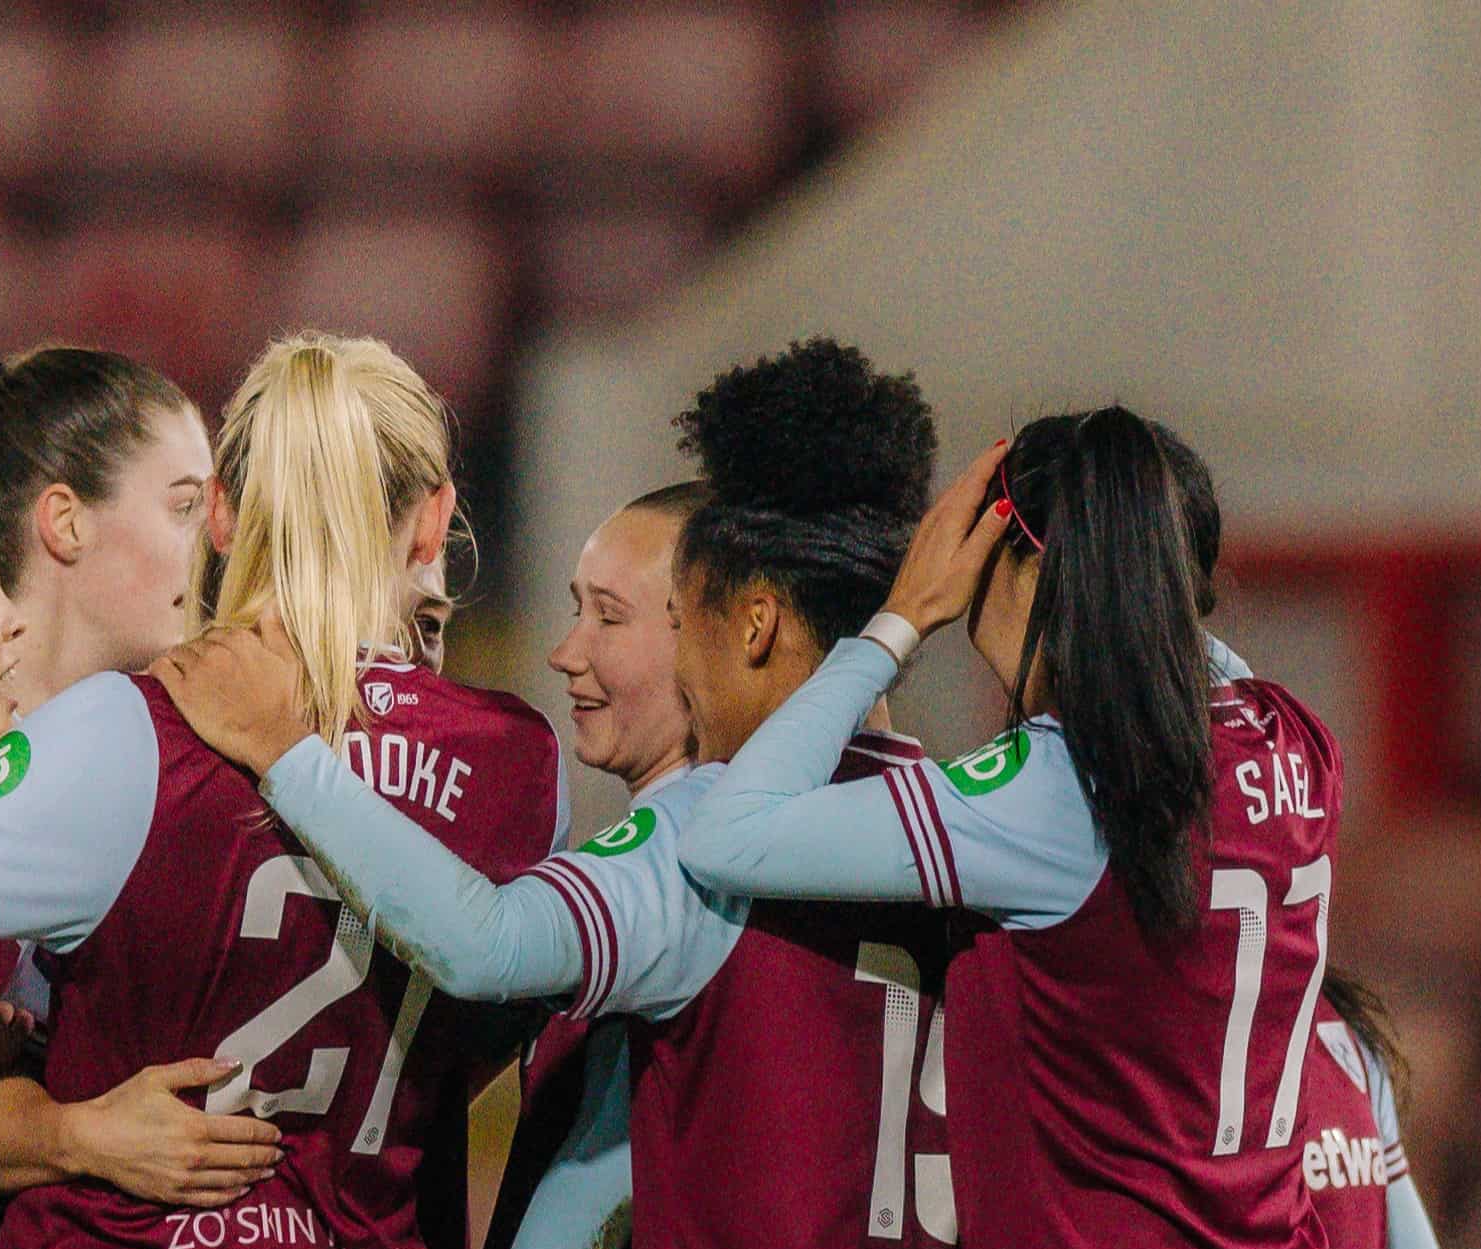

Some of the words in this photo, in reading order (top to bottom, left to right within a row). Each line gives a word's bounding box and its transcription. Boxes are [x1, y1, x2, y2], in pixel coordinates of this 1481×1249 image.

[342, 730, 473, 823] OOKE
[1211, 854, 1333, 1156] 77
[1302, 1126, 1388, 1192] etwa
[235, 1202, 317, 1246] SKIN
